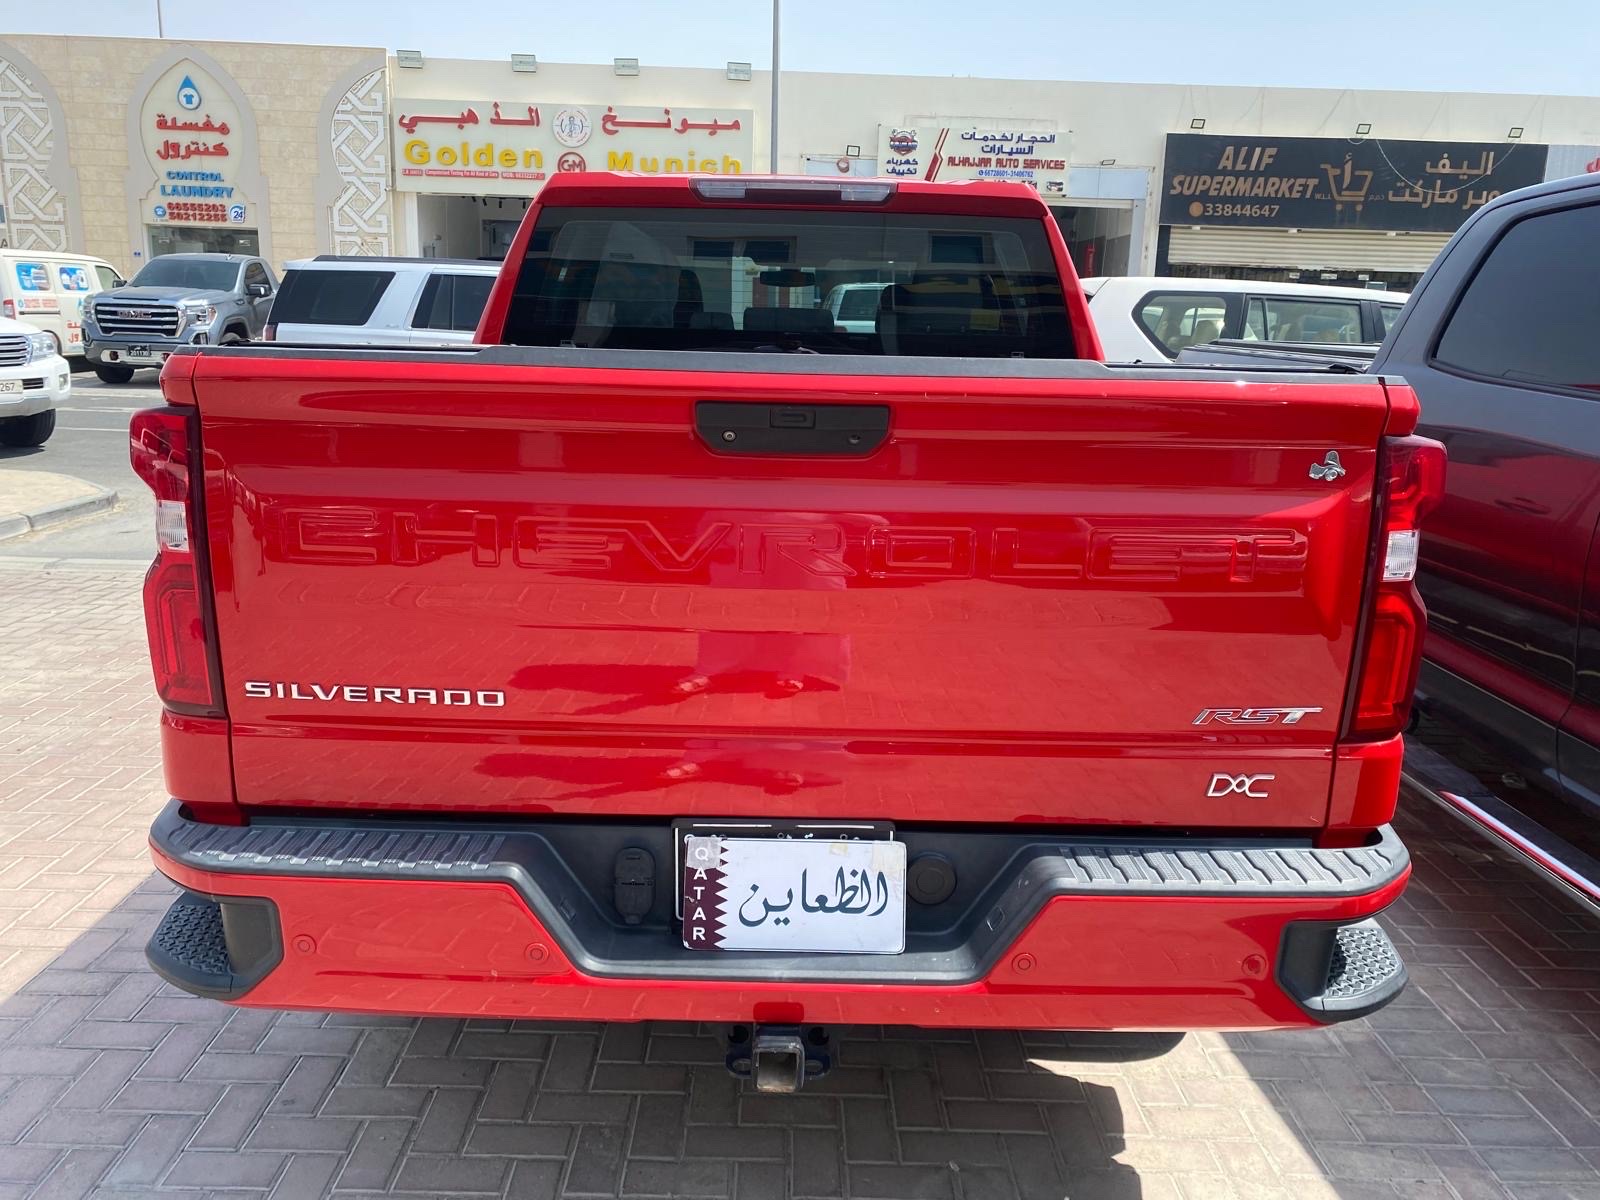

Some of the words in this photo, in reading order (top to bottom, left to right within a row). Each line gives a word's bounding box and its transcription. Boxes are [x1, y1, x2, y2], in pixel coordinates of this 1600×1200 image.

[156, 113, 230, 135] مغسلة
[961, 131, 1014, 142] لخدمات
[156, 139, 229, 160] كنترول
[404, 140, 543, 168] Golden
[607, 151, 742, 174] Munich
[981, 144, 1034, 156] السيارات
[1217, 146, 1278, 171] ALIF
[886, 157, 919, 167] كهرباء
[996, 157, 1019, 168] AUTO
[1023, 158, 1066, 170] SERVICES
[1425, 152, 1495, 179] اليف
[166, 170, 225, 182] CONTROL
[160, 184, 234, 198] LAUNDRY
[1169, 175, 1319, 199] SUPERMARKET
[1388, 179, 1458, 209] ماركت
[233, 210, 243, 219] 24
[1204, 203, 1280, 217] 33844647
[282, 508, 1308, 584] CHEVROLET
[244, 681, 506, 707] SILVERADO
[1191, 707, 1323, 725] RST
[692, 847, 709, 941] QATAR
[738, 866, 889, 928] الظعاين
